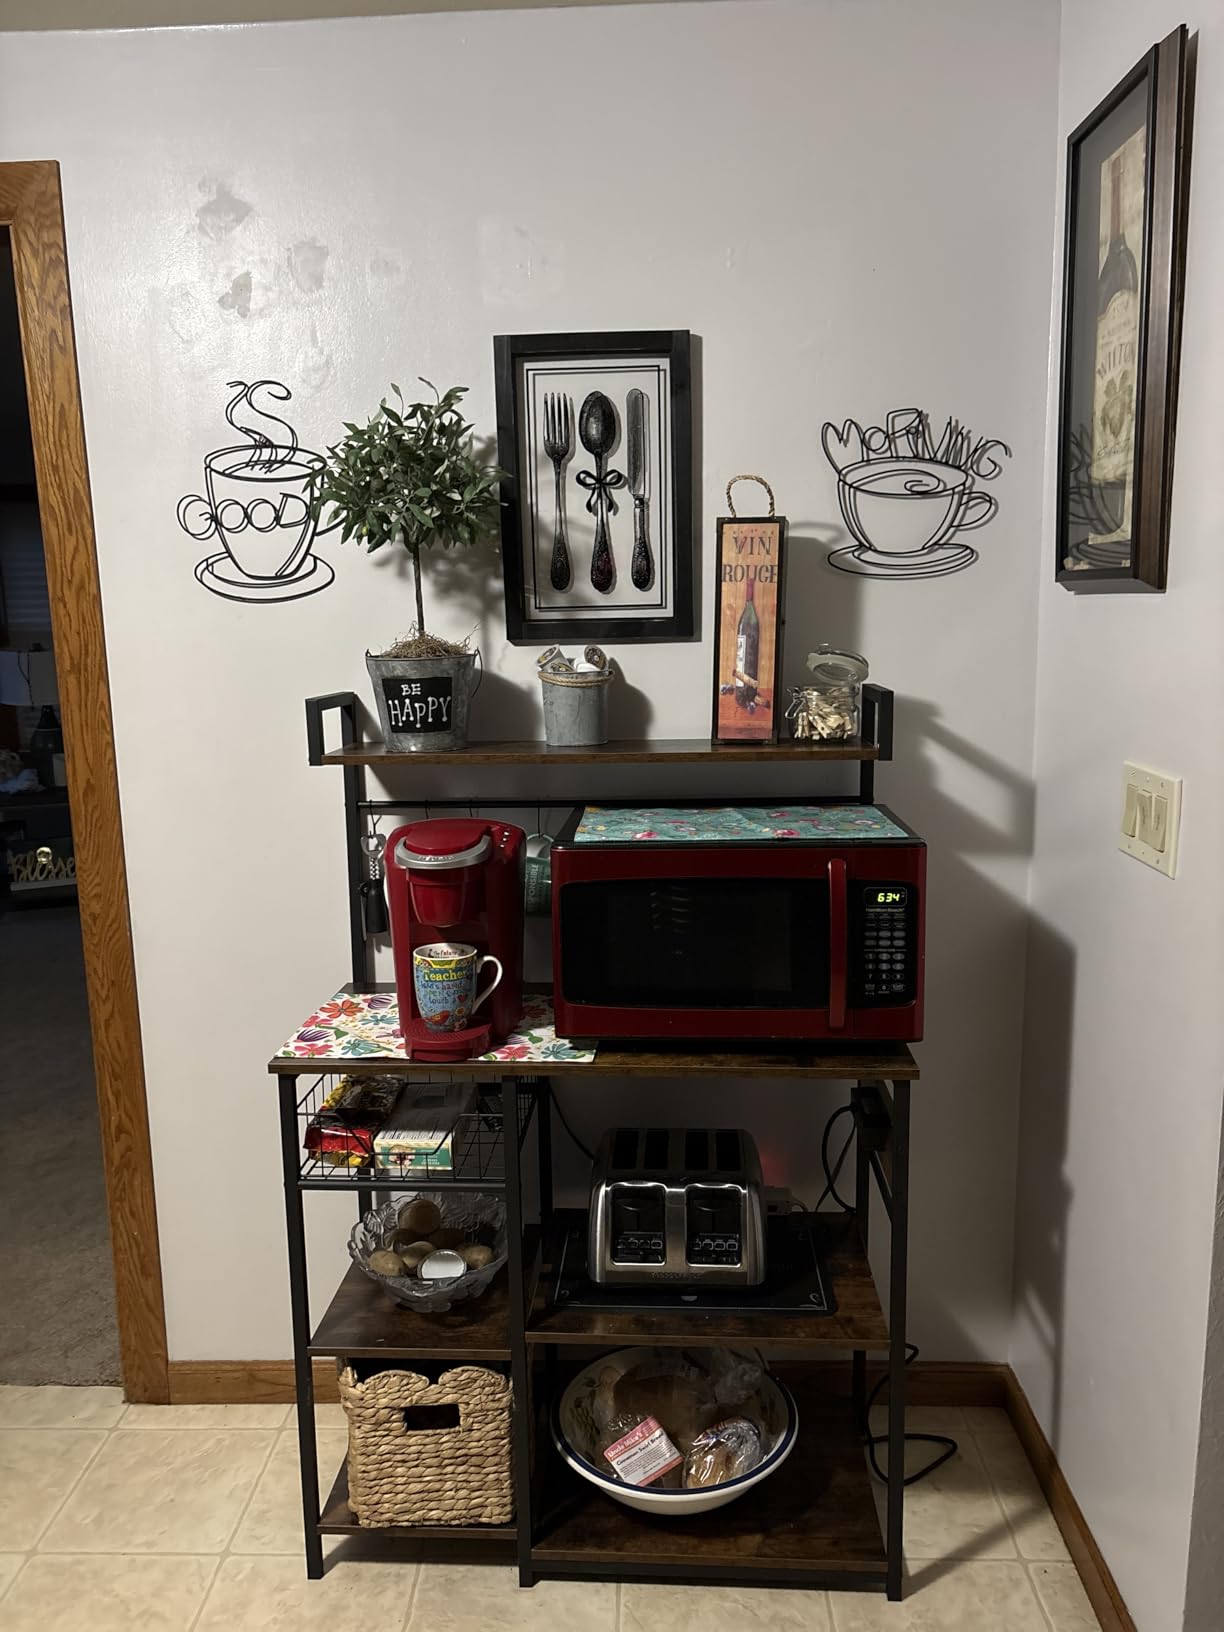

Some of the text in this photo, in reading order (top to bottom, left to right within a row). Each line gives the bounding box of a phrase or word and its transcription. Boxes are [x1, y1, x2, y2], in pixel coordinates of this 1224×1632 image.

[177, 493, 309, 540] GOOD
[732, 536, 773, 556] VIN
[721, 563, 779, 584] ROUGE
[401, 683, 421, 696] BE
